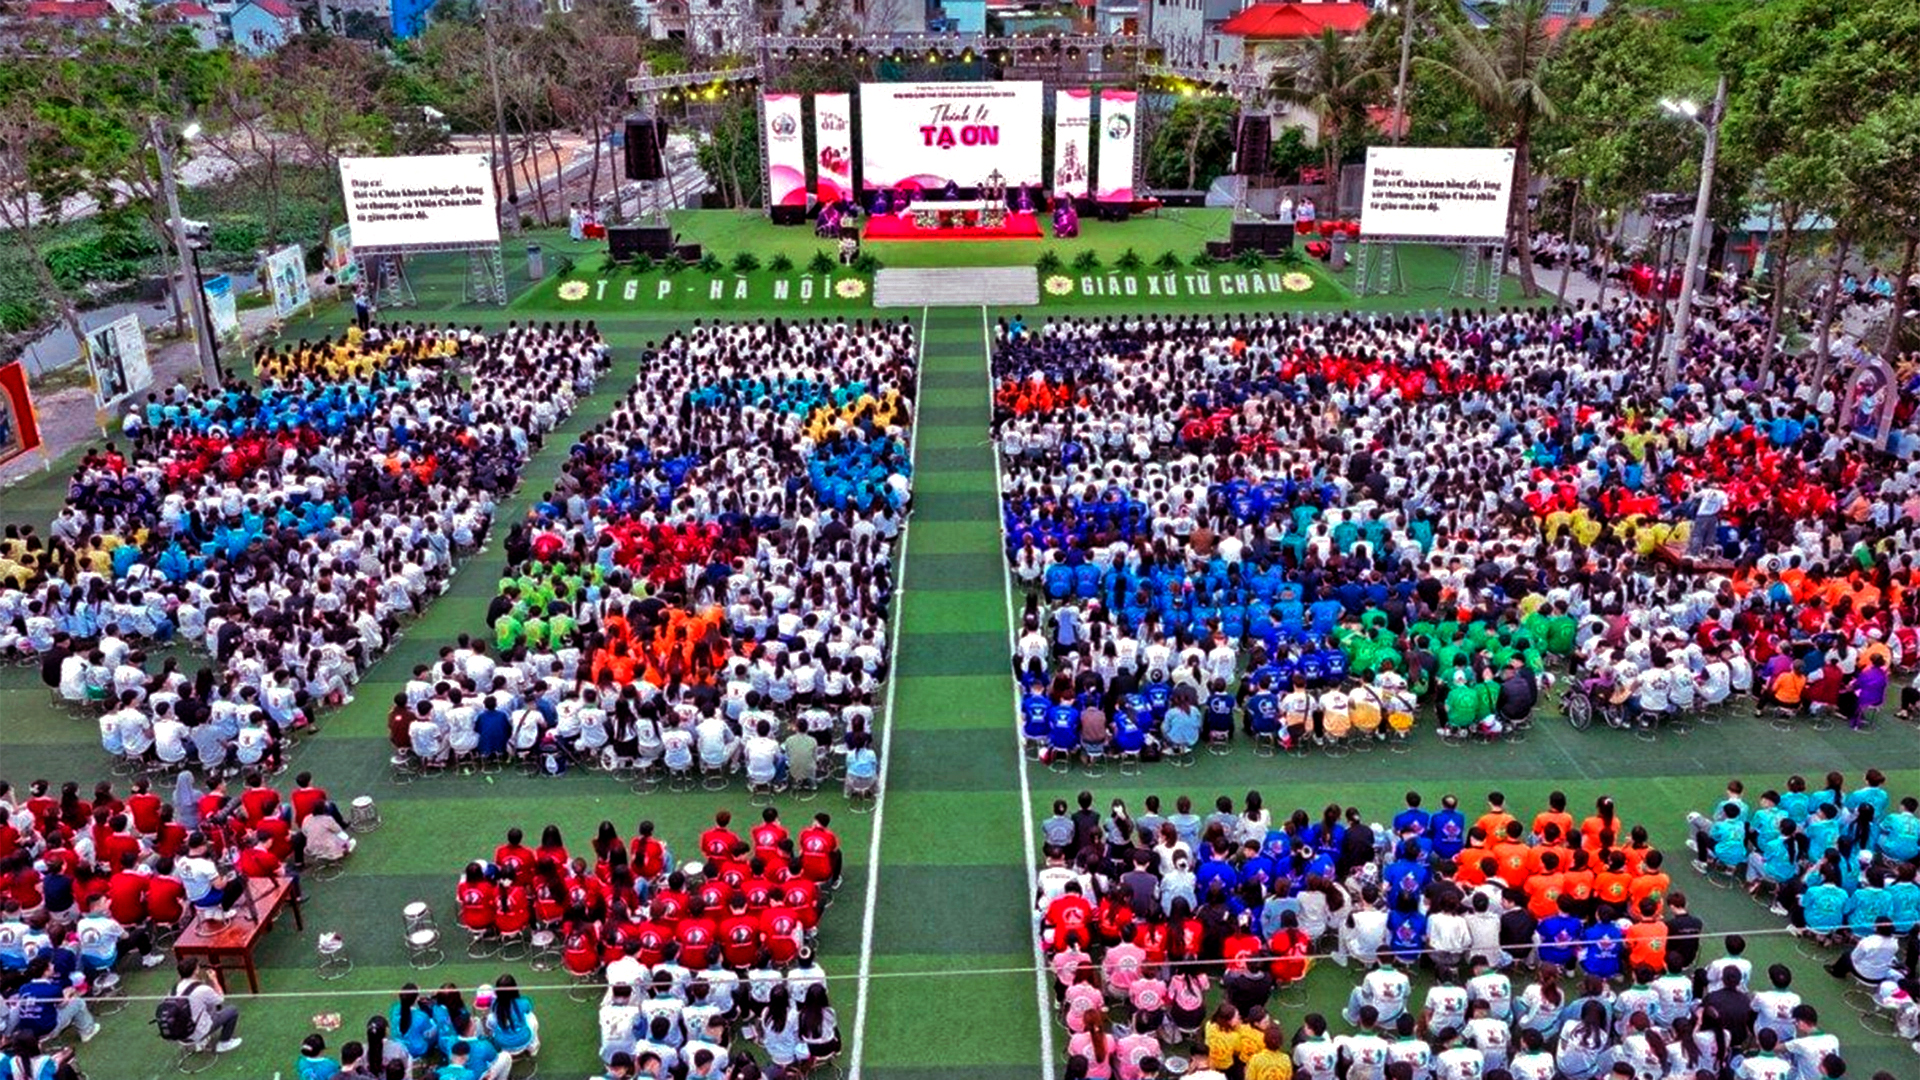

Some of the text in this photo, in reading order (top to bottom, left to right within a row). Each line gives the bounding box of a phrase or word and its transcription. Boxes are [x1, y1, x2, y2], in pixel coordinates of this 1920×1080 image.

[919, 125, 999, 150] TẠ ƠN
[709, 274, 747, 299] HÀ
[773, 273, 831, 304] NỘI
[1081, 269, 1138, 296] GIÁO
[1147, 269, 1178, 296] XỨ
[1219, 268, 1283, 295] CHÂU
